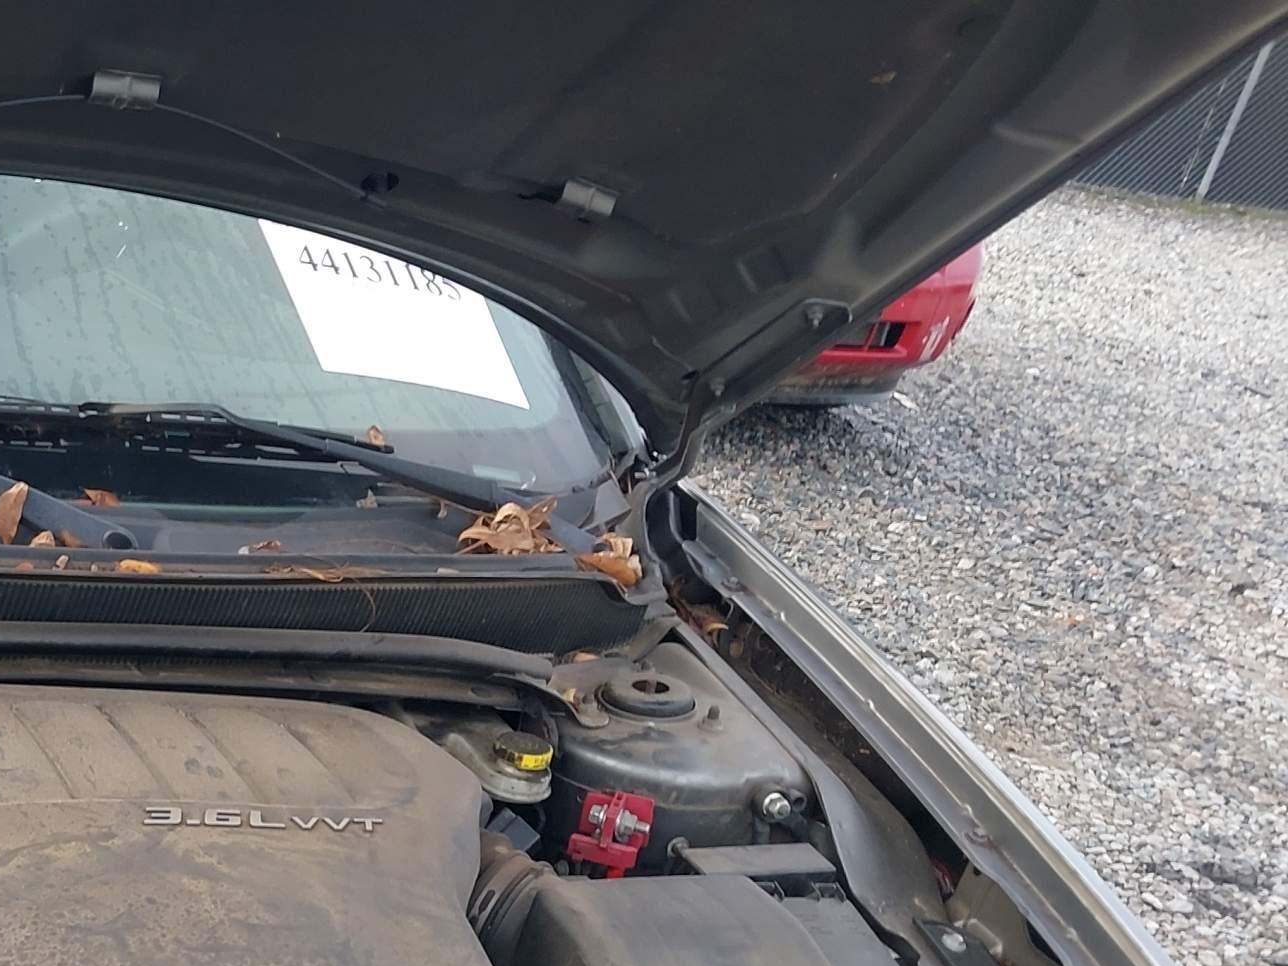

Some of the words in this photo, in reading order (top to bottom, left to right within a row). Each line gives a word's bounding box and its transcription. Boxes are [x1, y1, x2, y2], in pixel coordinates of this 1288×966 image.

[298, 244, 463, 302] 44131185
[142, 806, 287, 829] 3.6L
[290, 815, 384, 833] VVT
